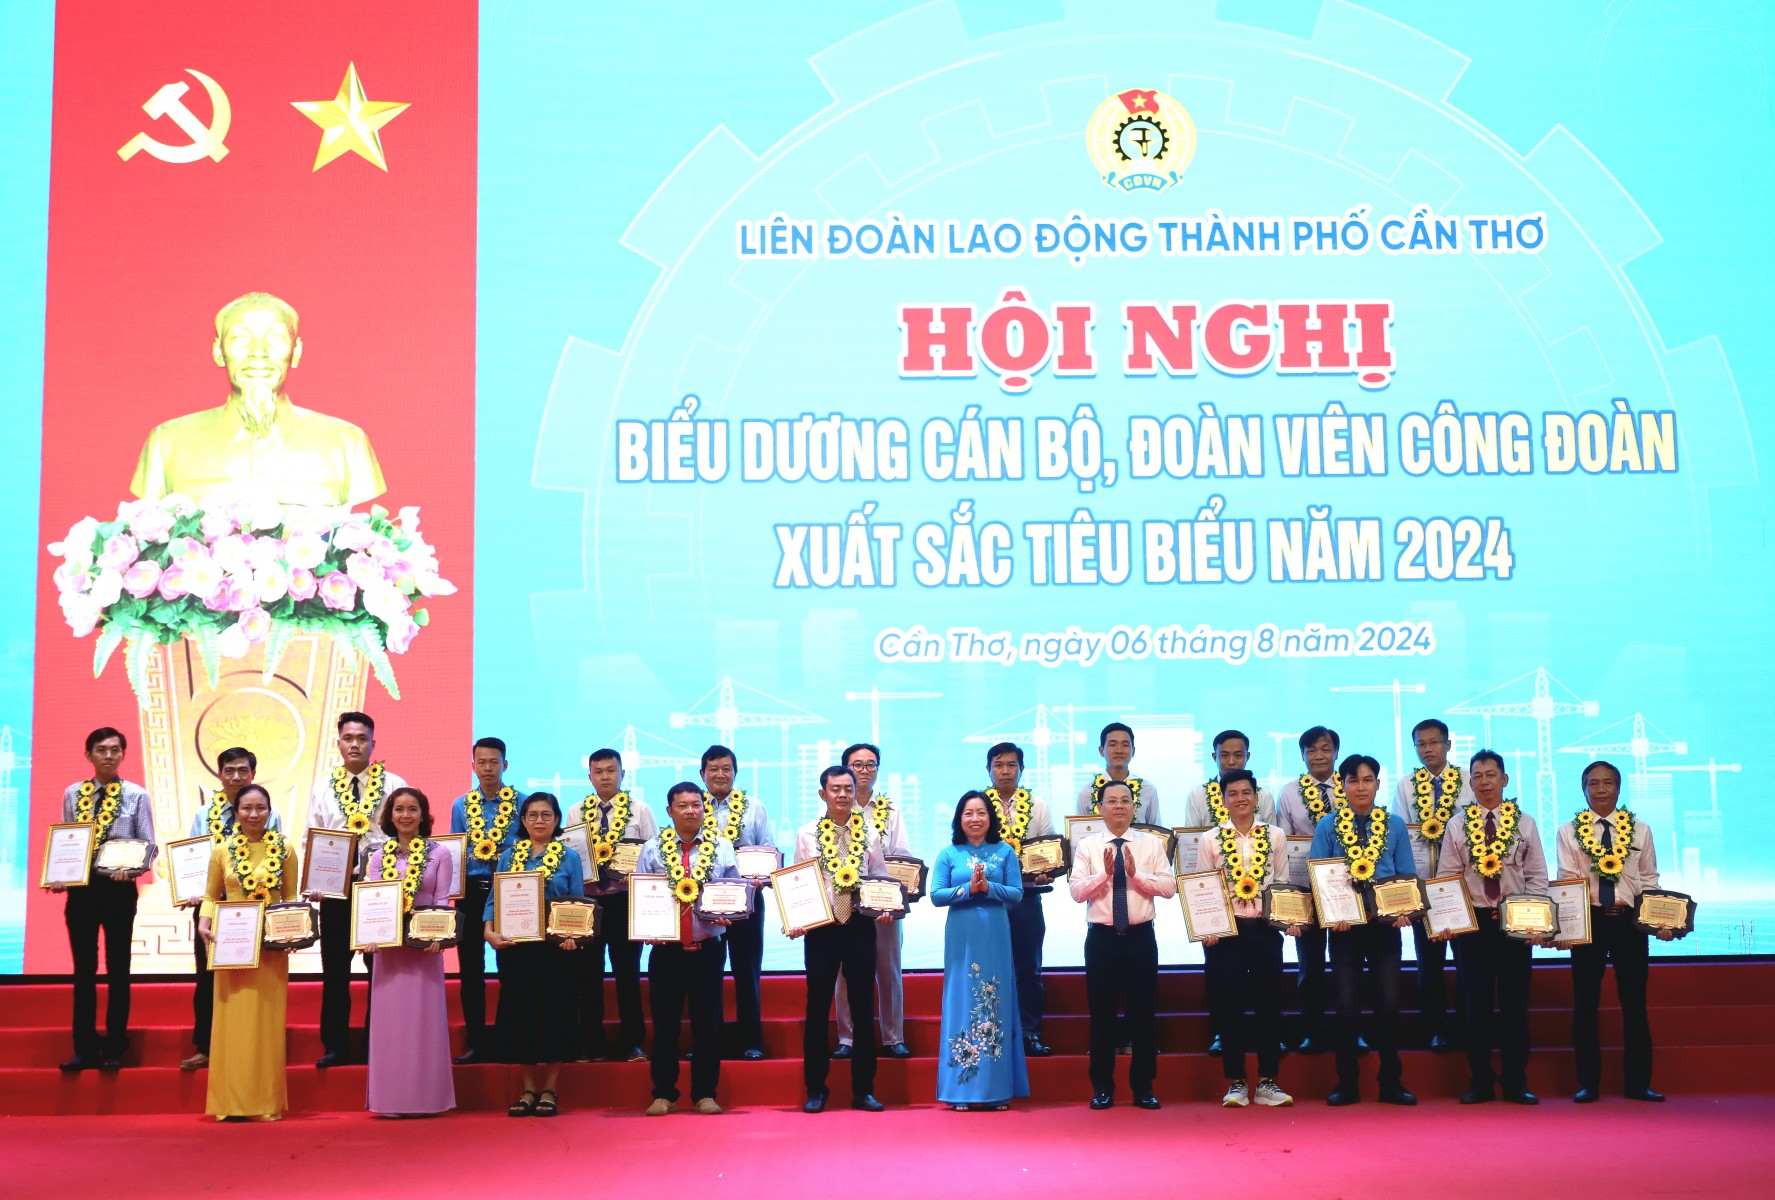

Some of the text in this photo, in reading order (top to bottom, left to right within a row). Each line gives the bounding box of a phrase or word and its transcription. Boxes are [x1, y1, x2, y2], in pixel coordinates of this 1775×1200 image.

[741, 207, 1544, 263] LIÊN ĐOÀN LAO ĐỘNG THÀNH PHỐ CẦN THƠ
[902, 290, 1391, 387] HỘI NGHỊ
[616, 395, 1678, 493] BIỂU DƯƠNG CÁN BỘ, ĐOÀN VIÊN CÔNG ĐOÀN
[773, 494, 1515, 588] XUẤT SẮC TIÊU BIỂU NĂM 2024
[879, 626, 1431, 663] Cần Thơ, ngày 06 tháng 8 năm 2024
